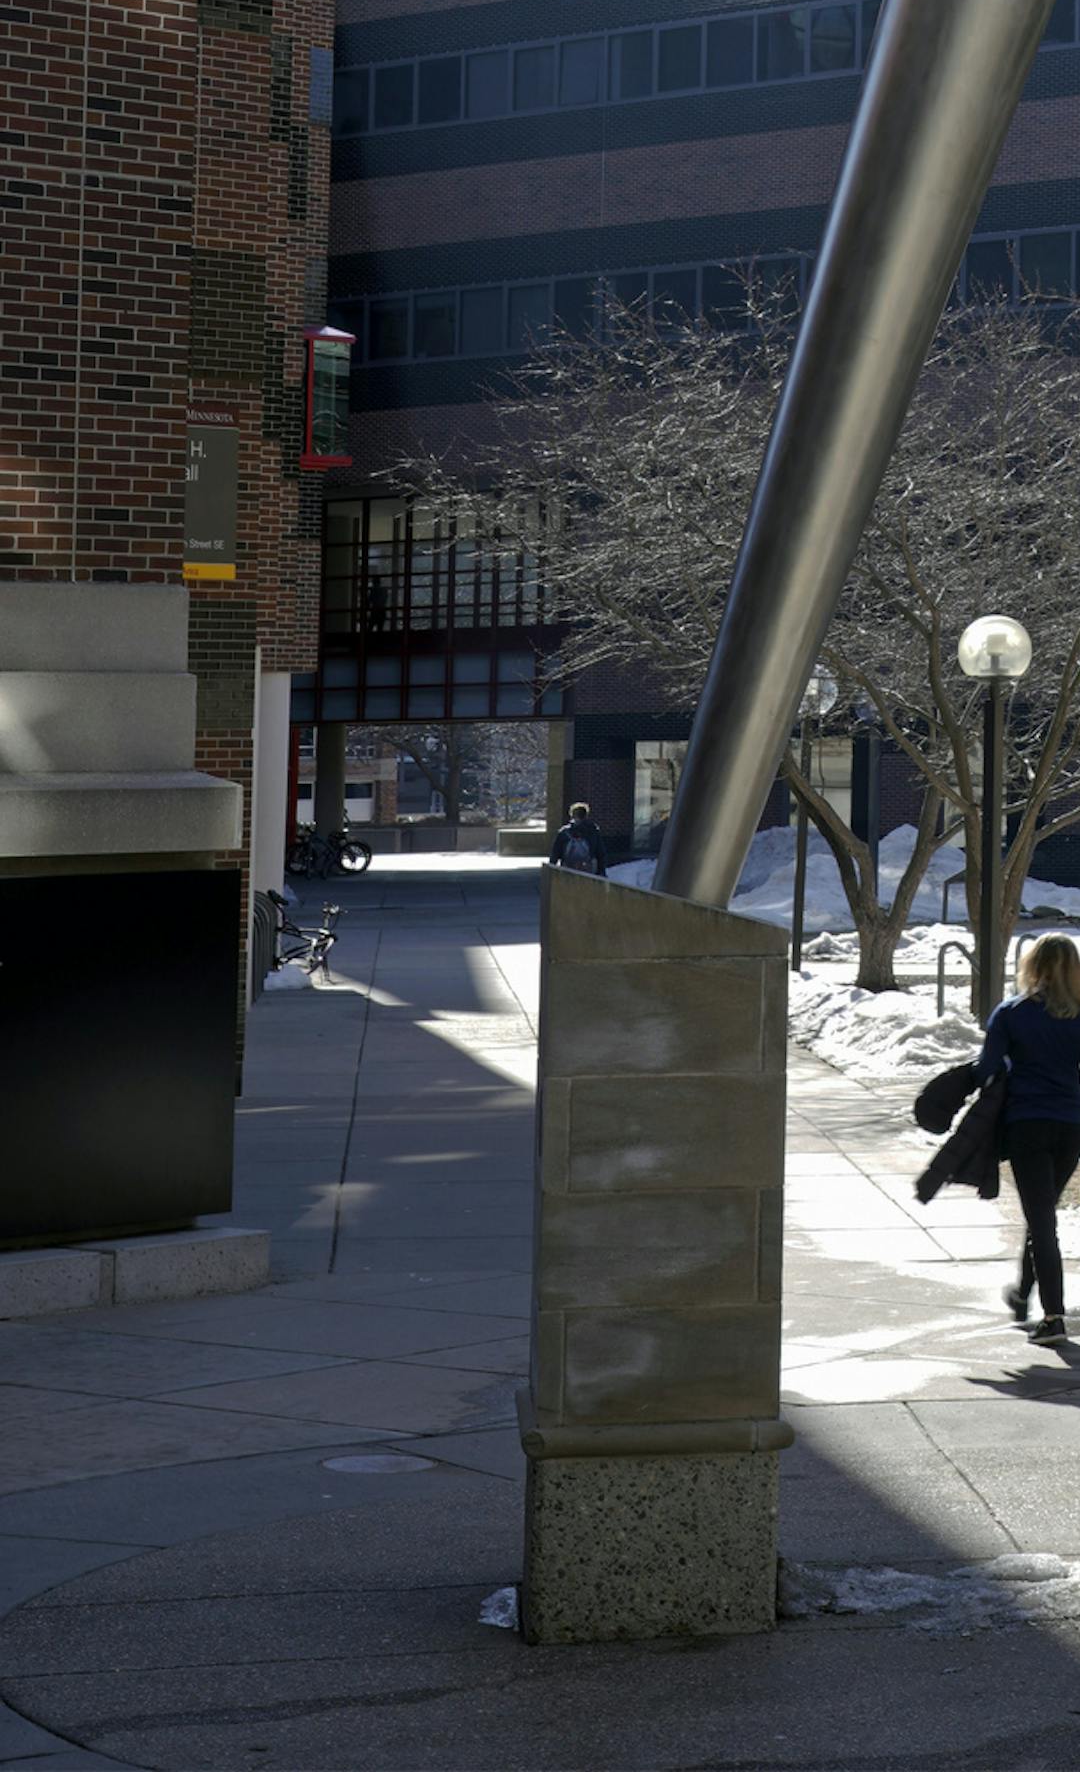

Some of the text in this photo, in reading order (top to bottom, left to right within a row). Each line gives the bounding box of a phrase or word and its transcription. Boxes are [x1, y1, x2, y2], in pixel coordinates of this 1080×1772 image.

[190, 440, 207, 458] H.
[184, 464, 199, 481] all
[189, 538, 212, 549] Street
[213, 539, 225, 550] SE
